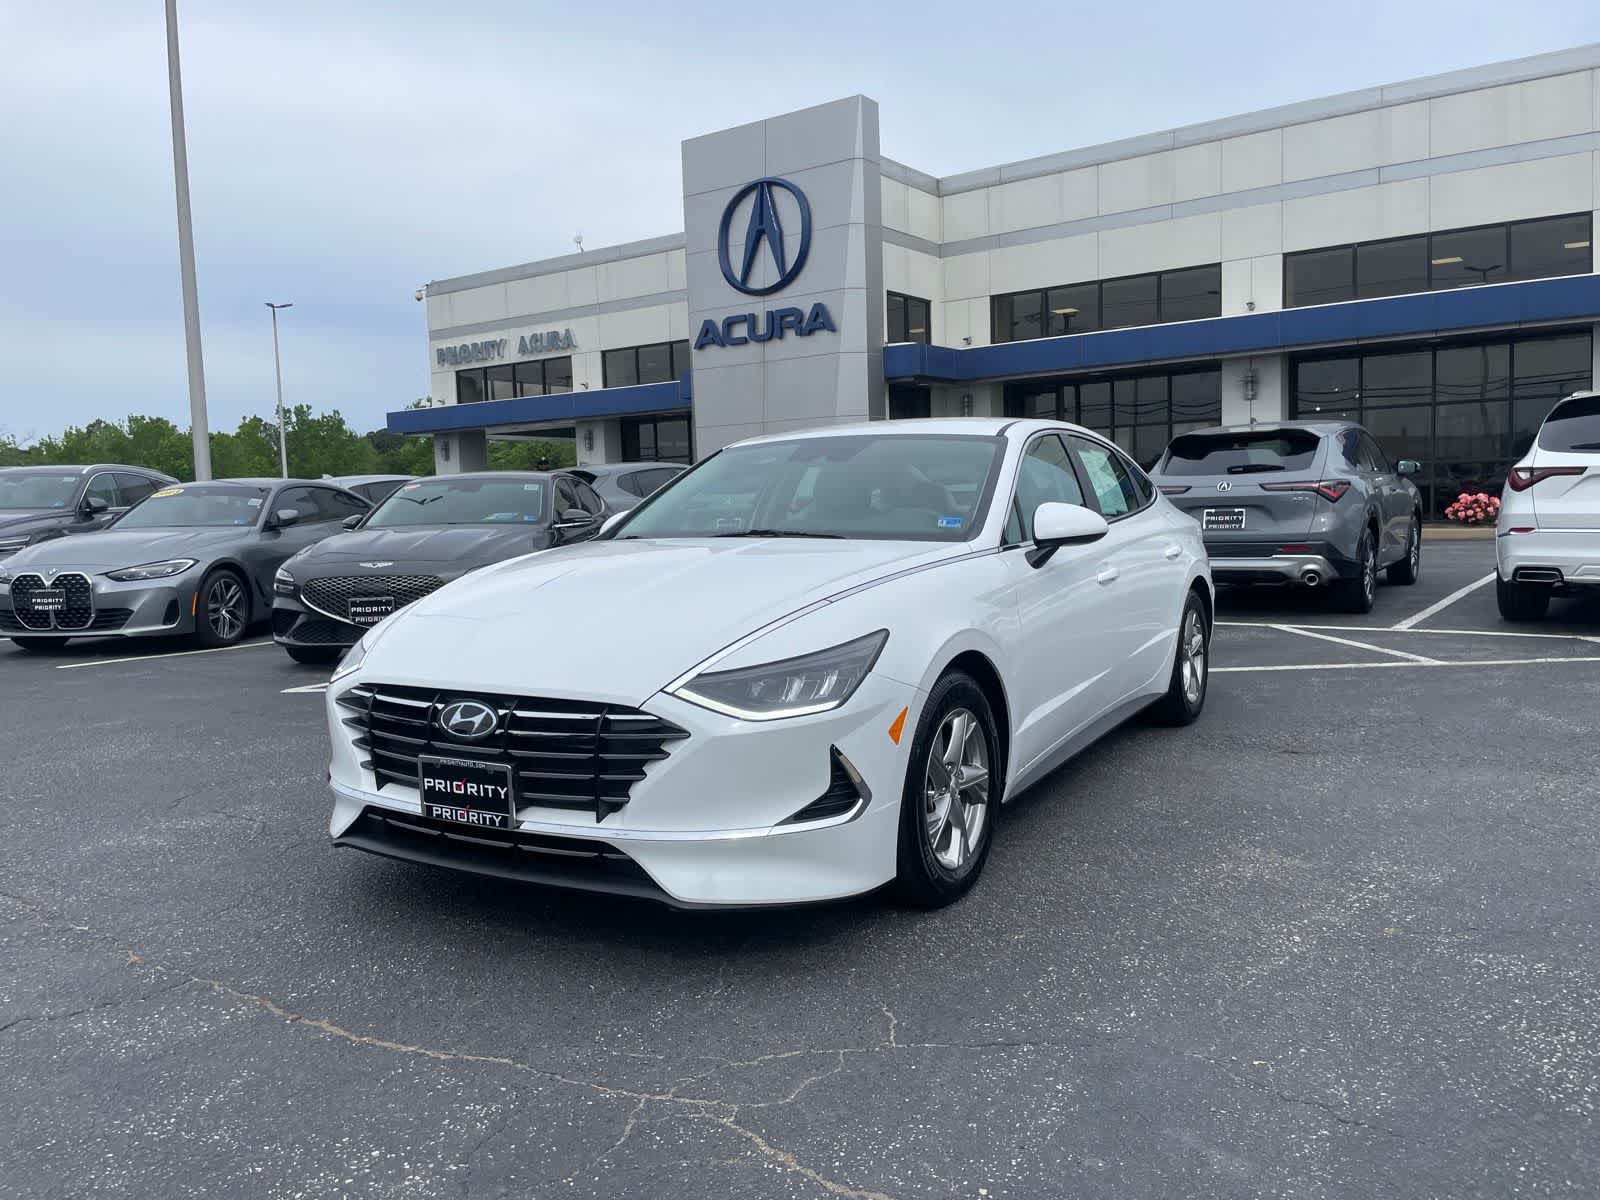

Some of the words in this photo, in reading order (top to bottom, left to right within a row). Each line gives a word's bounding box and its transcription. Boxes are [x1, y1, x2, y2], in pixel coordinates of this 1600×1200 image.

[693, 302, 837, 350] ACURA
[436, 338, 506, 367] PRIORITY
[517, 328, 577, 356] ACURA
[424, 777, 508, 799] PRIORITY
[432, 806, 502, 827] PRIORITY
